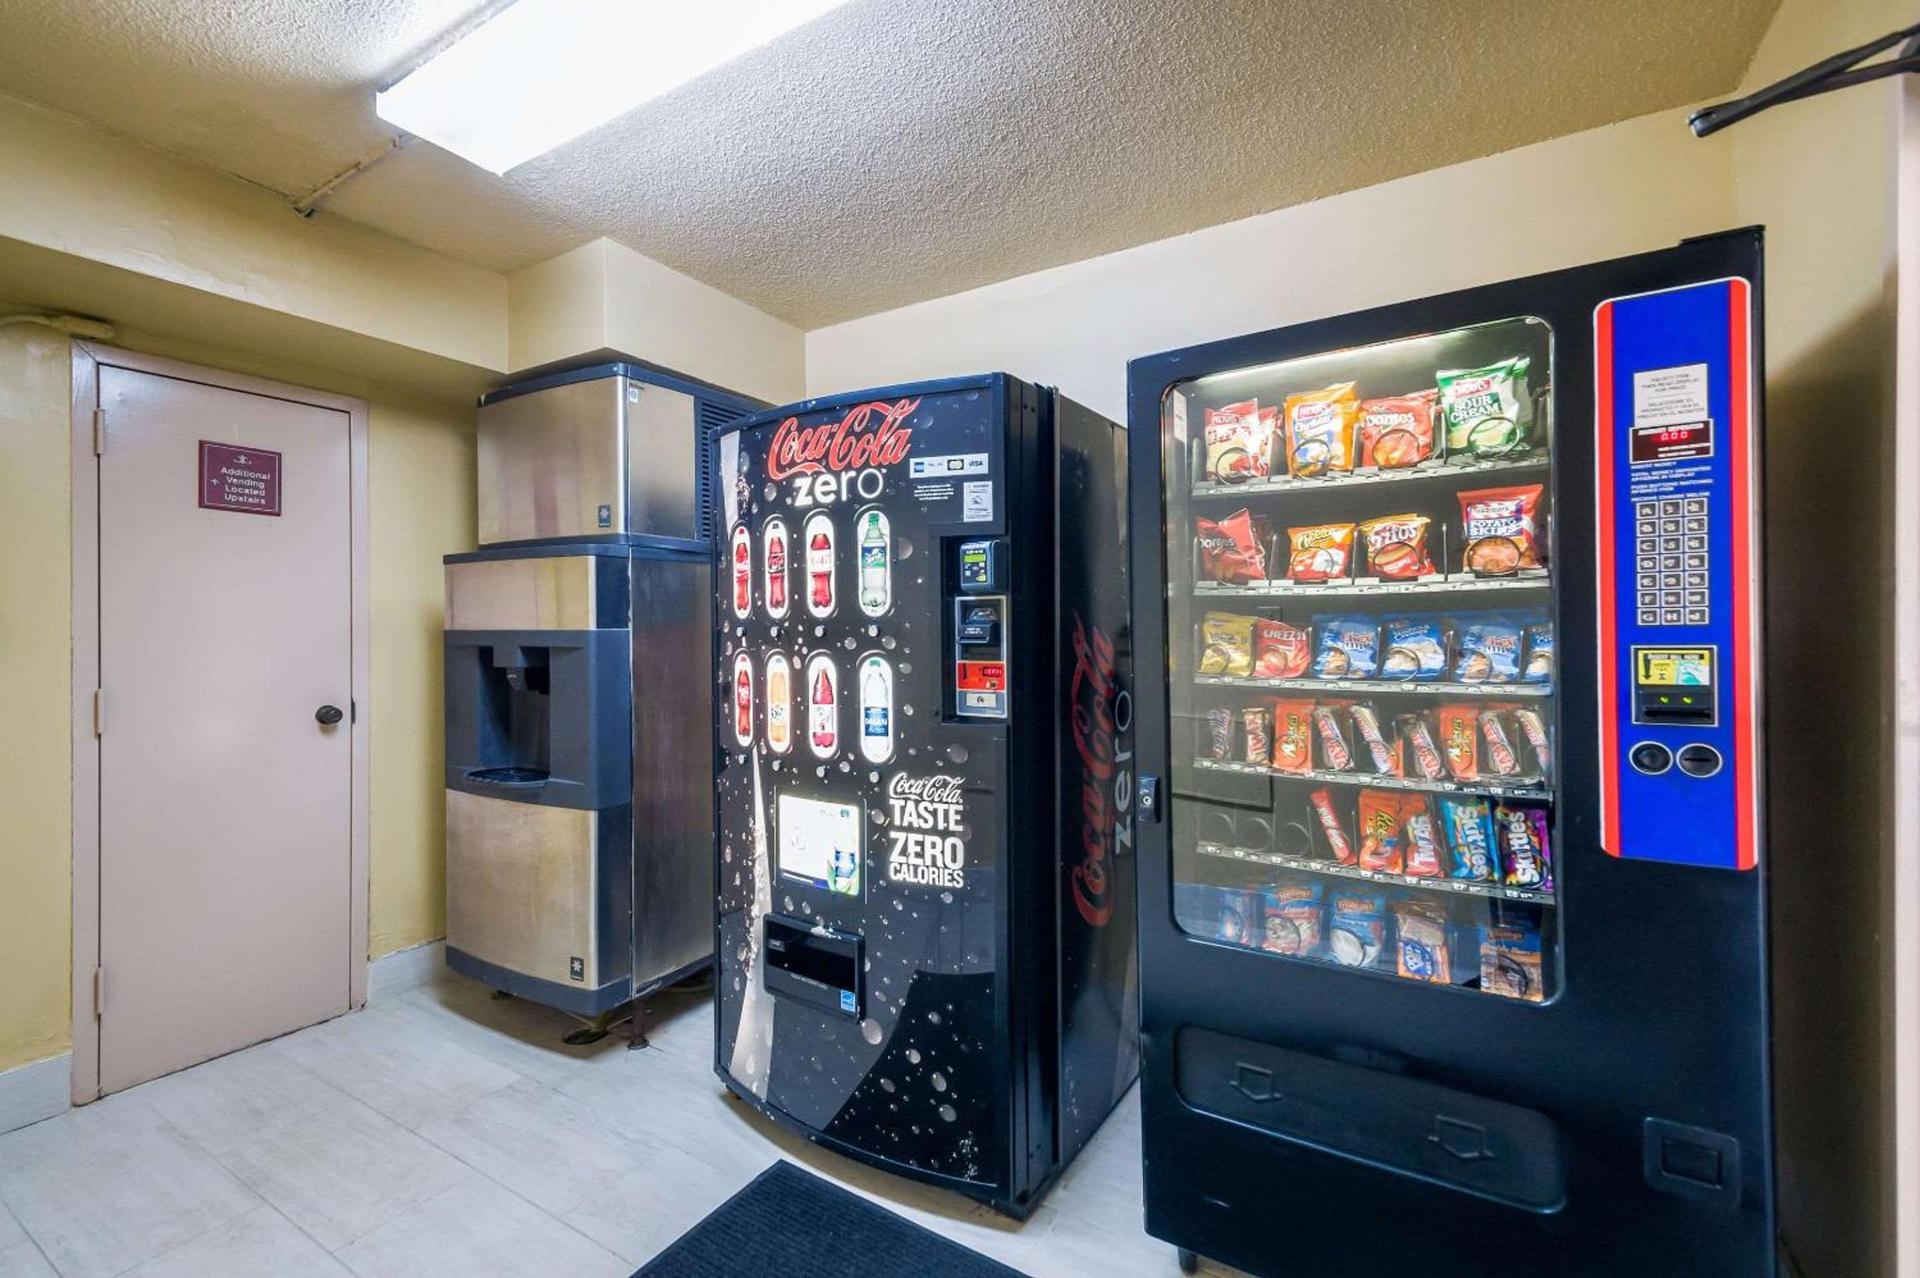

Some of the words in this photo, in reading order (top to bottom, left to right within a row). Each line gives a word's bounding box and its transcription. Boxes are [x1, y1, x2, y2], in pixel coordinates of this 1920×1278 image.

[1450, 404, 1500, 423] CREAM
[1455, 395, 1492, 411] SOUR
[767, 396, 921, 480] Coca-Cola
[221, 467, 271, 480] Additional
[226, 476, 265, 489] Vending
[224, 493, 266, 505] Upstairs
[225, 484, 266, 496] Located
[792, 468, 884, 508] zero
[1072, 608, 1115, 927] Coca-Cola
[1114, 690, 1132, 855] zero
[889, 772, 967, 803] Coca-Cola
[889, 799, 964, 831] TASTE
[889, 831, 965, 870] ZERO
[889, 862, 964, 888] CALORIES
